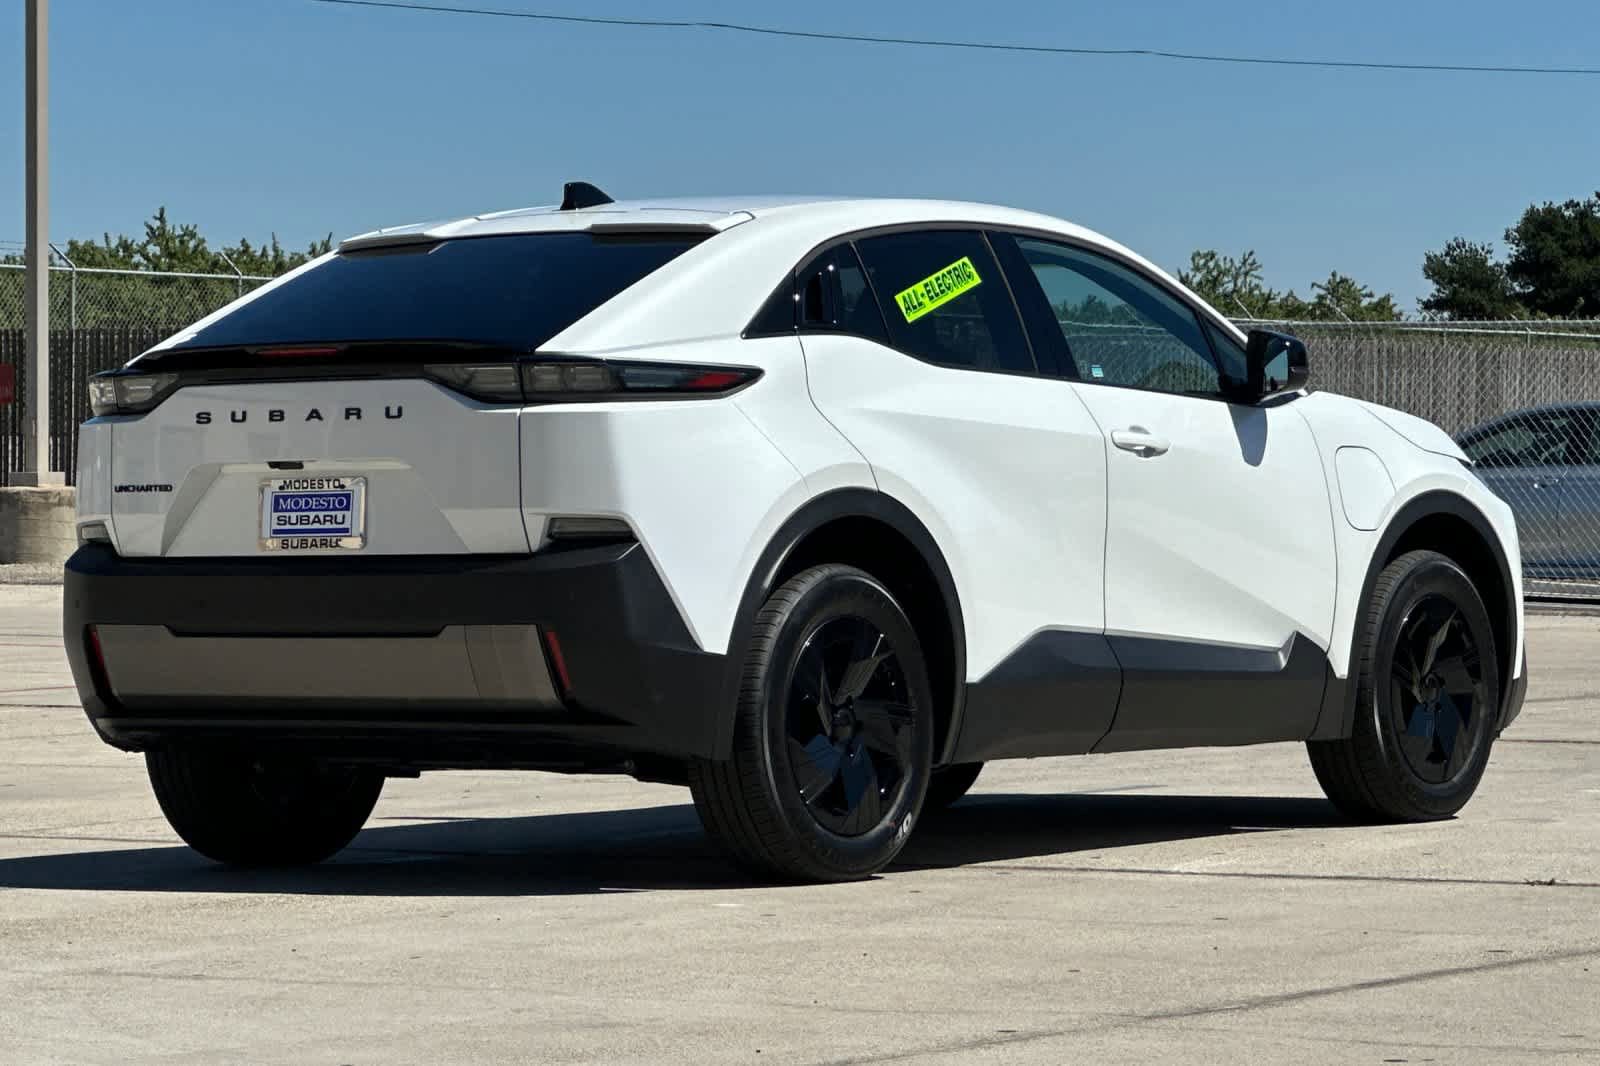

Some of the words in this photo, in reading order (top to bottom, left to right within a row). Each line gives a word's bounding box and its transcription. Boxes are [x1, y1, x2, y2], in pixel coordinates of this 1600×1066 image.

[195, 406, 403, 424] SUBARU
[114, 484, 173, 493] UNCHARTED
[282, 479, 341, 490] MODESTO
[279, 496, 347, 510] MODESTO
[276, 514, 346, 526] SUBARU
[281, 538, 341, 549] SUBARU
